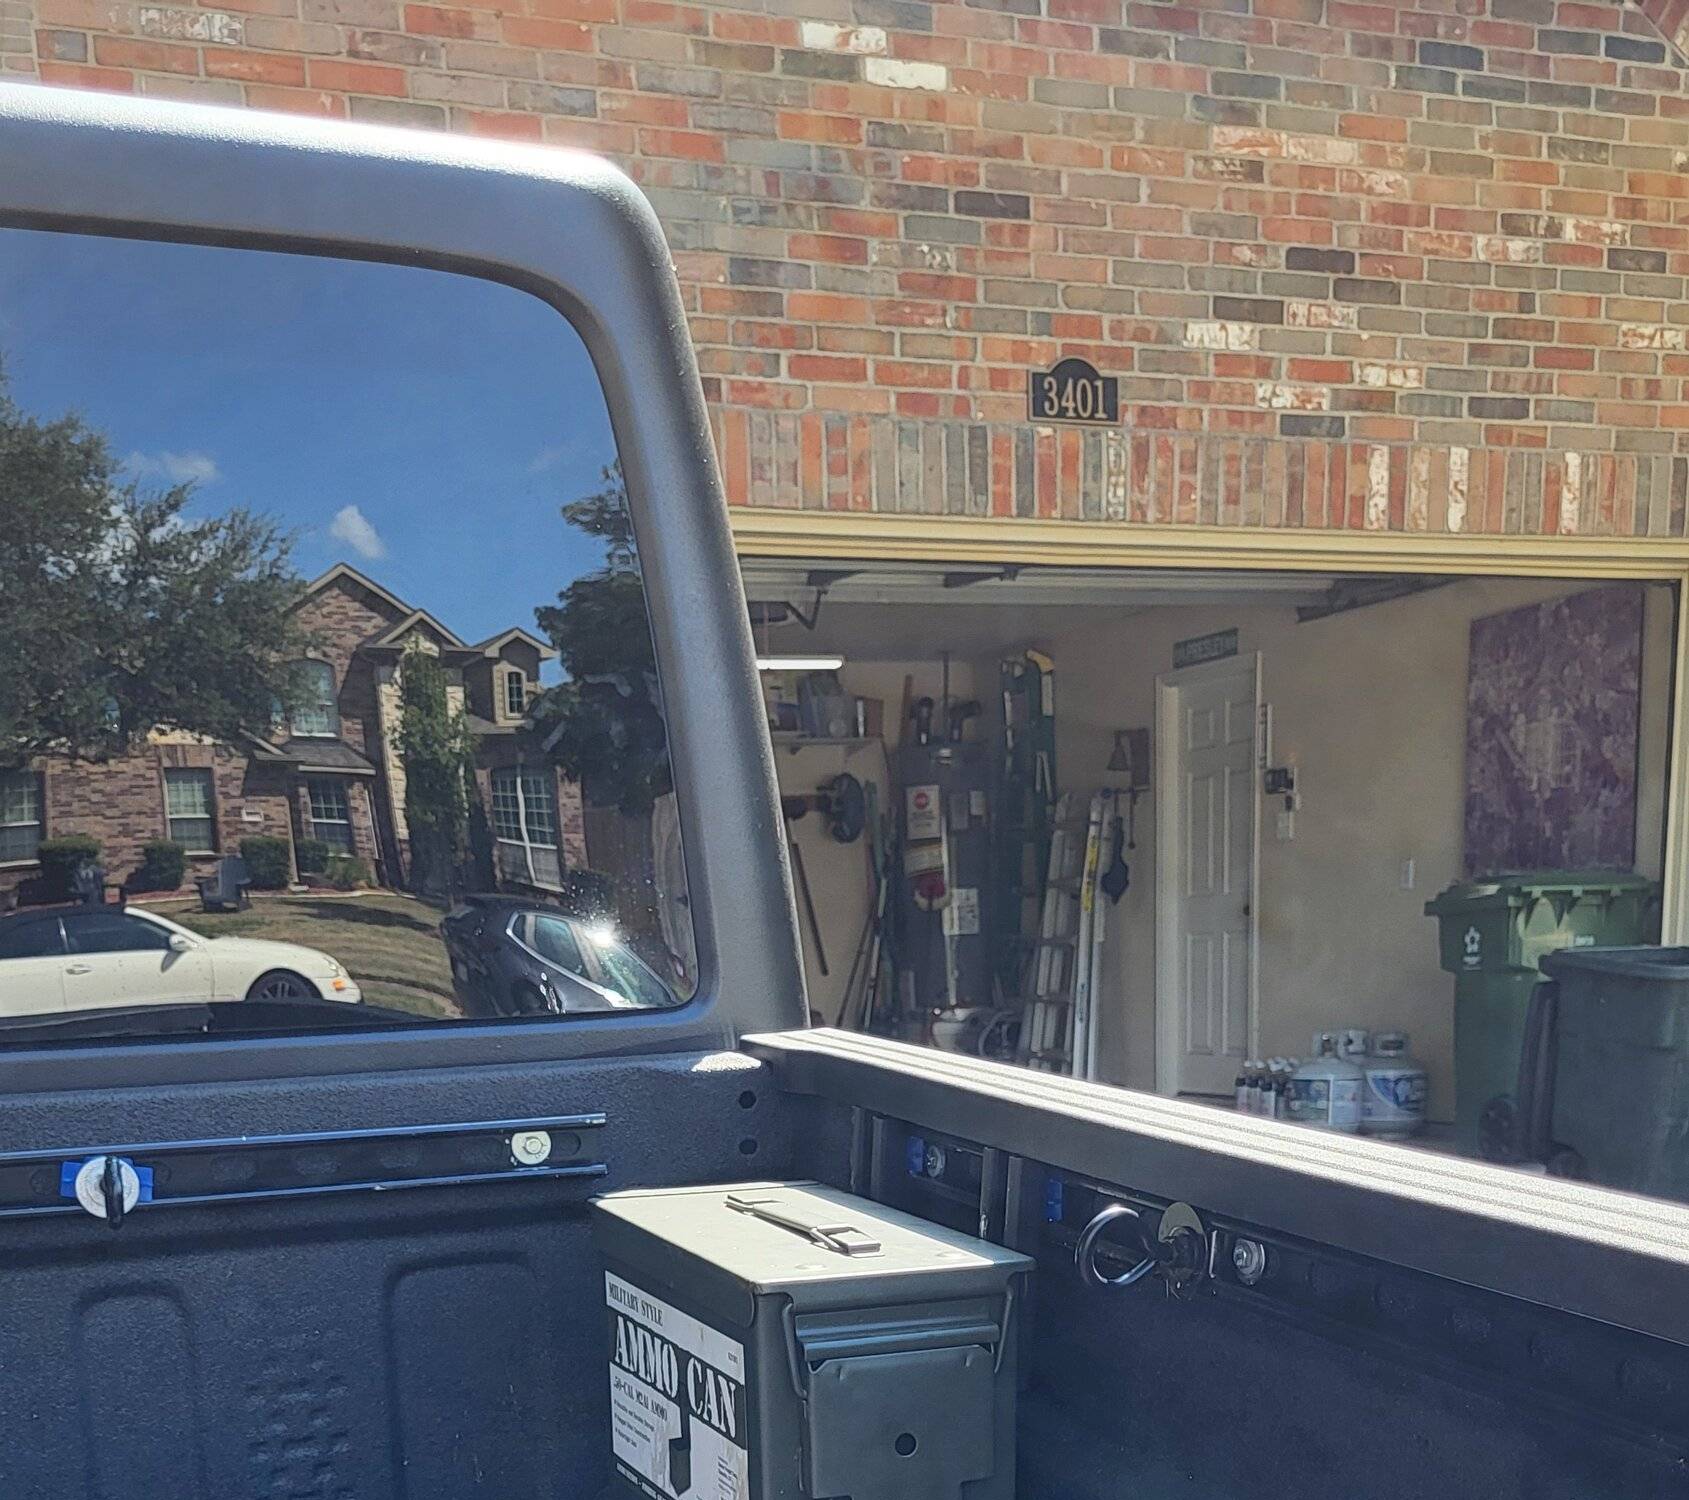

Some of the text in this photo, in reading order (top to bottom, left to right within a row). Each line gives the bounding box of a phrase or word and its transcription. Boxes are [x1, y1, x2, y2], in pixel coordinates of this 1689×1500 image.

[1043, 376, 1108, 419] 3401
[609, 1281, 663, 1327] MILITARY STYLE
[615, 1315, 679, 1398] AMMO
[687, 1357, 736, 1438] CAN
